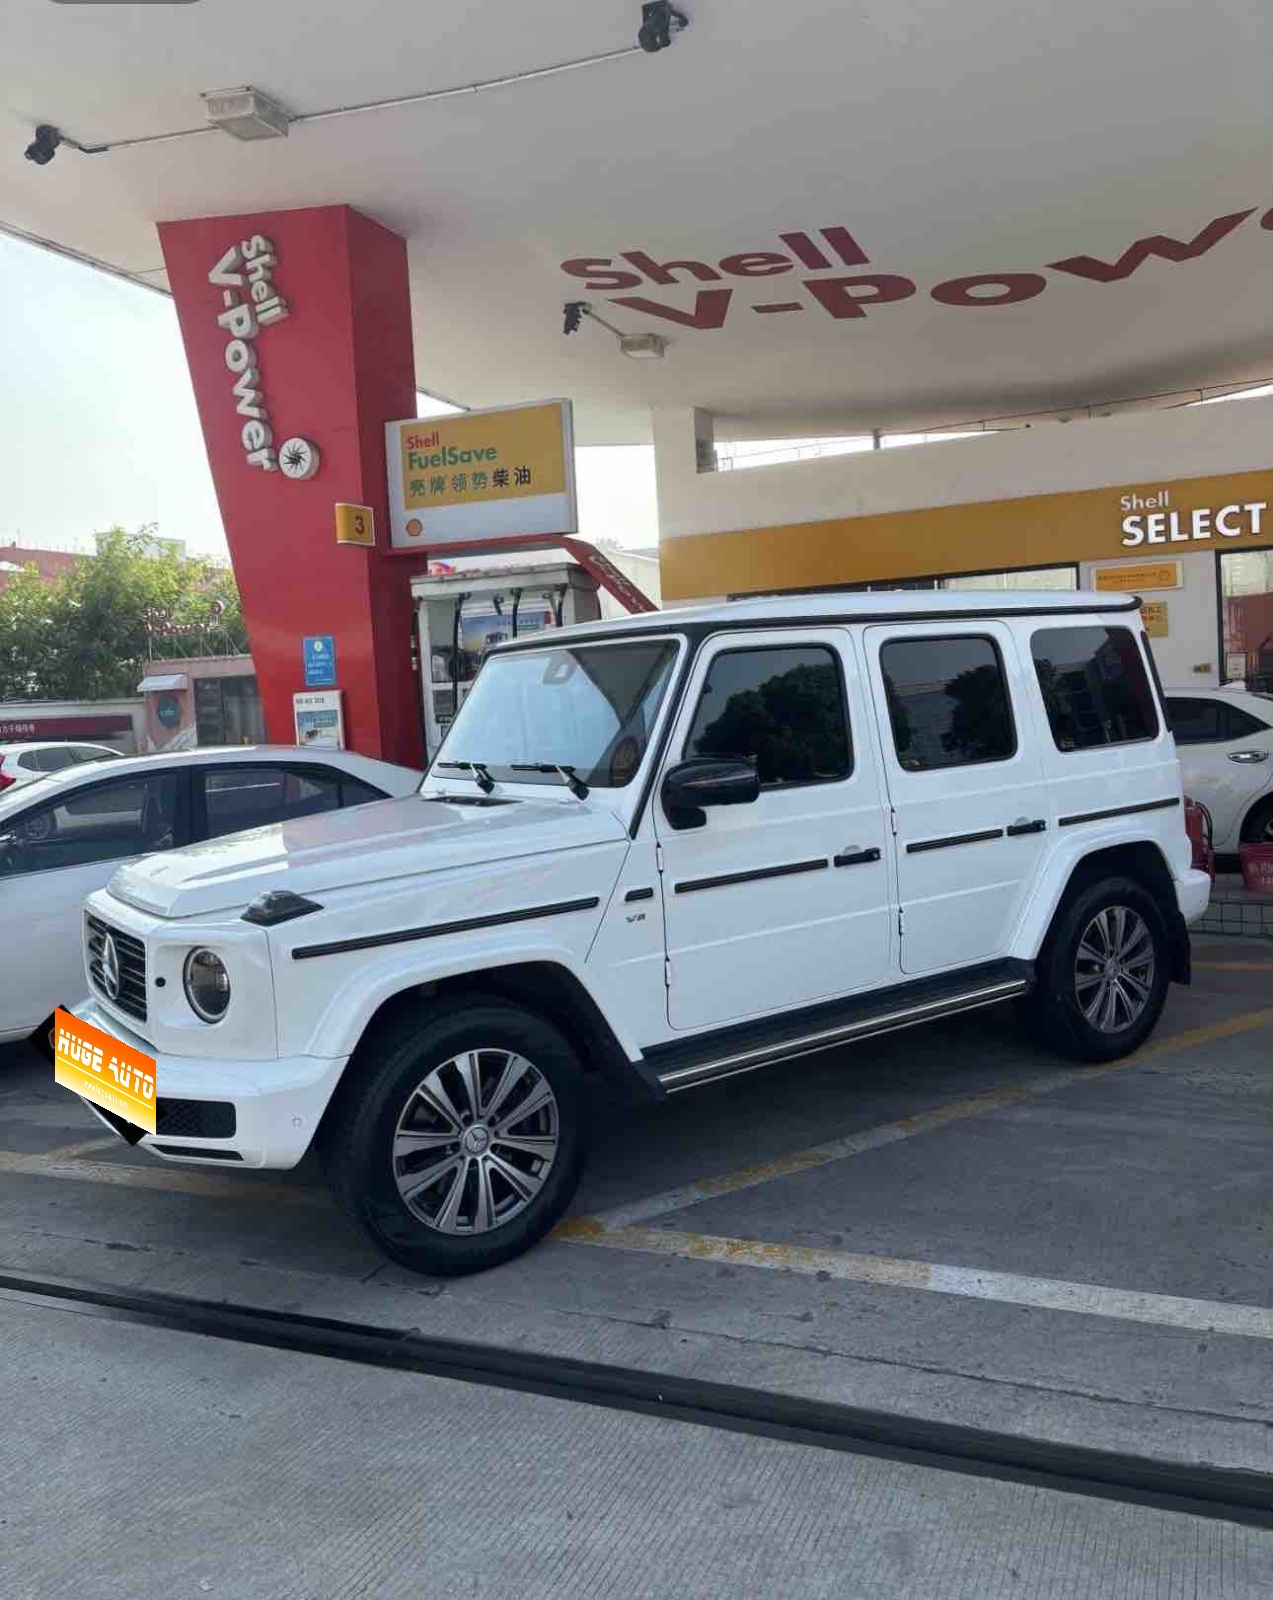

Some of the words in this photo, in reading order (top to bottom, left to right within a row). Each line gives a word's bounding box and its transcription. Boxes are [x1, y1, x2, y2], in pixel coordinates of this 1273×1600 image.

[241, 235, 289, 326] Shell
[560, 226, 871, 291] Shell
[608, 206, 1273, 330] V-Pow
[208, 246, 279, 472] V-Power
[406, 430, 440, 450] Shell
[408, 446, 498, 470] FuelSave
[1120, 490, 1169, 512] Shell
[1121, 501, 1267, 547] SELECT
[354, 515, 366, 535] 3
